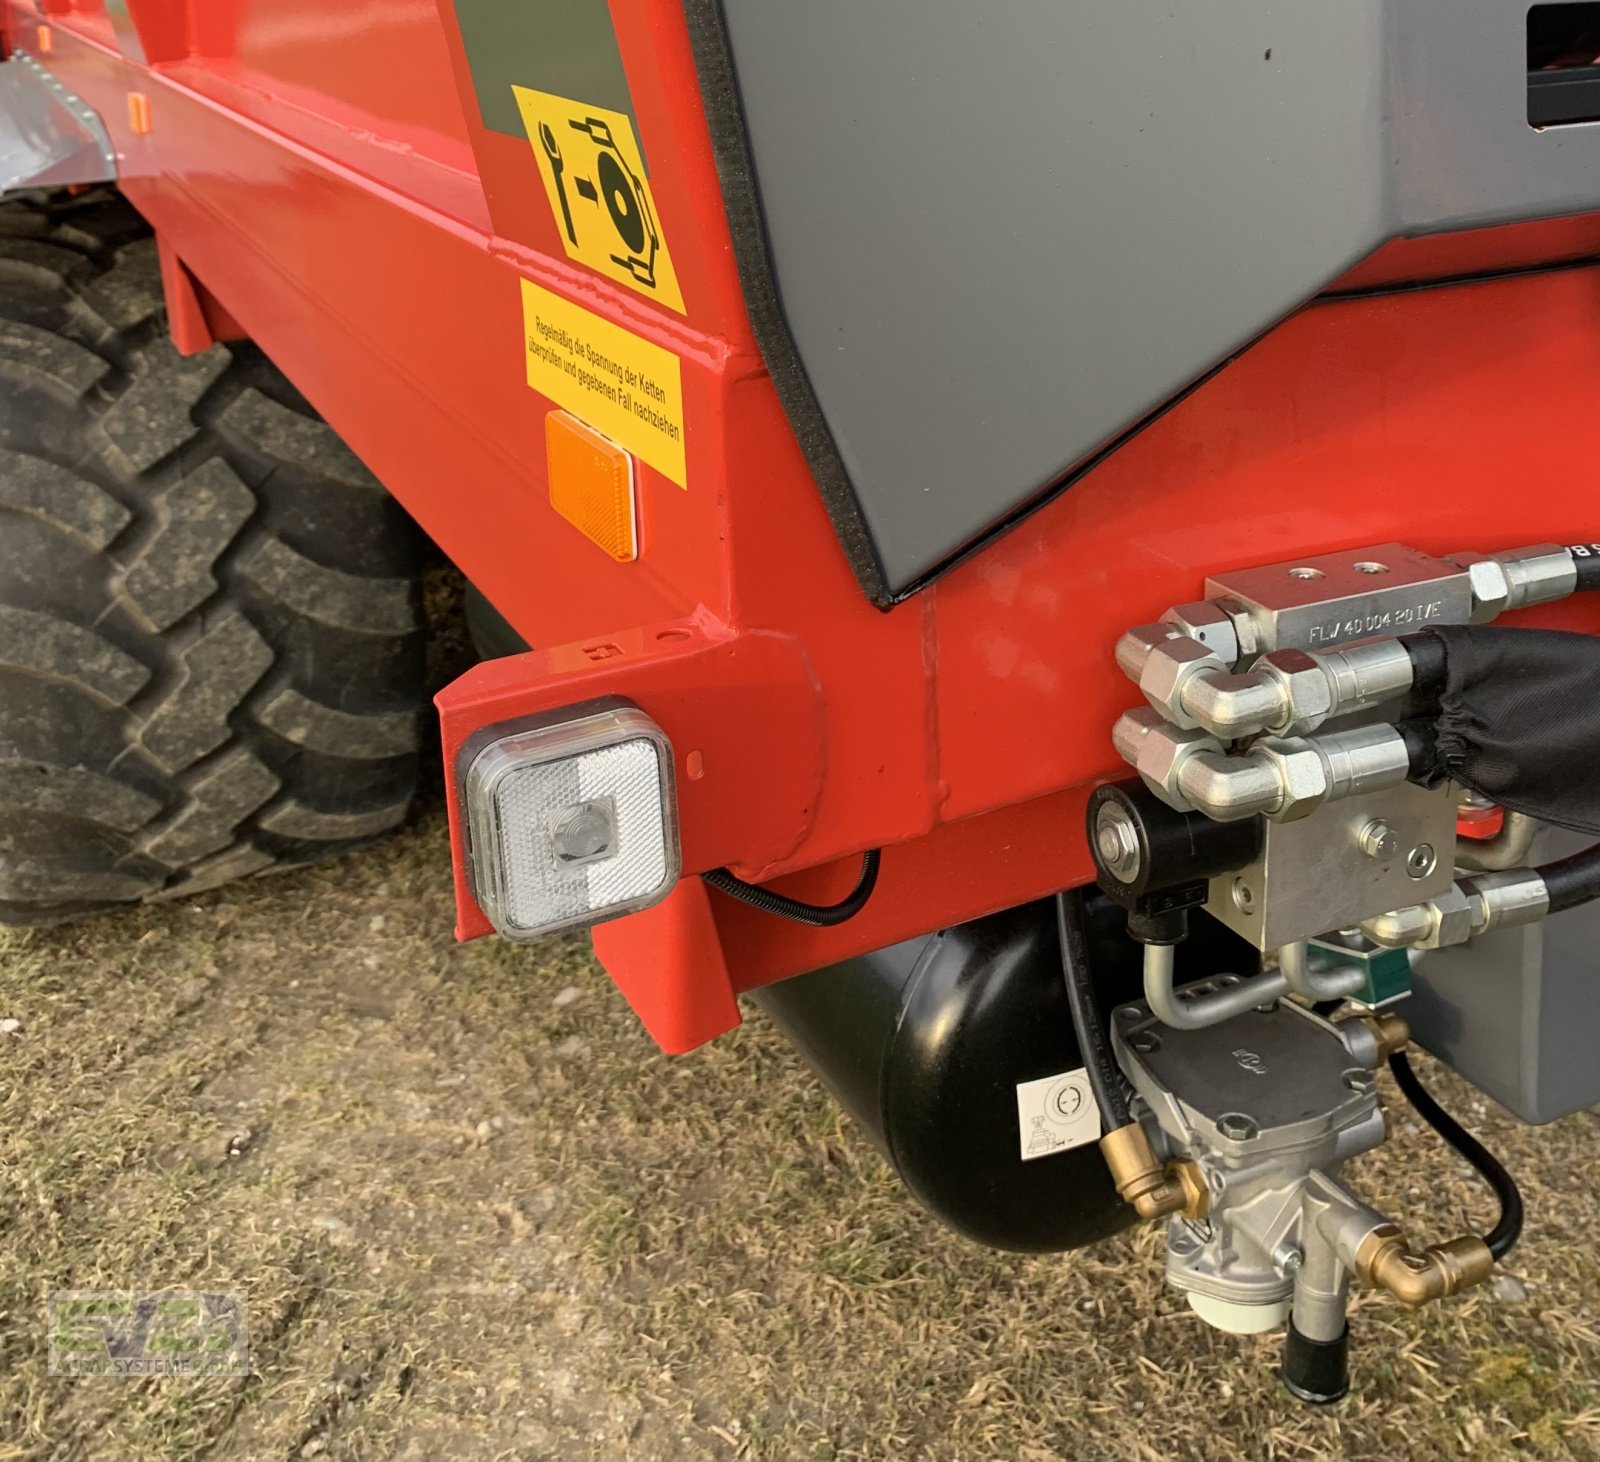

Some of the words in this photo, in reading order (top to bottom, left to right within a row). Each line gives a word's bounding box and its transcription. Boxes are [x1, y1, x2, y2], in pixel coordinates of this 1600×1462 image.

[528, 336, 563, 370] überprüfen
[563, 359, 577, 378] und
[577, 368, 617, 403] gegebenen
[617, 387, 632, 412] Fall
[633, 400, 680, 442] nachziehen
[535, 315, 574, 355] Regelmäßig
[575, 338, 585, 358] die
[586, 343, 624, 385] Spannung
[624, 365, 638, 388] der
[638, 371, 666, 405] Ketten
